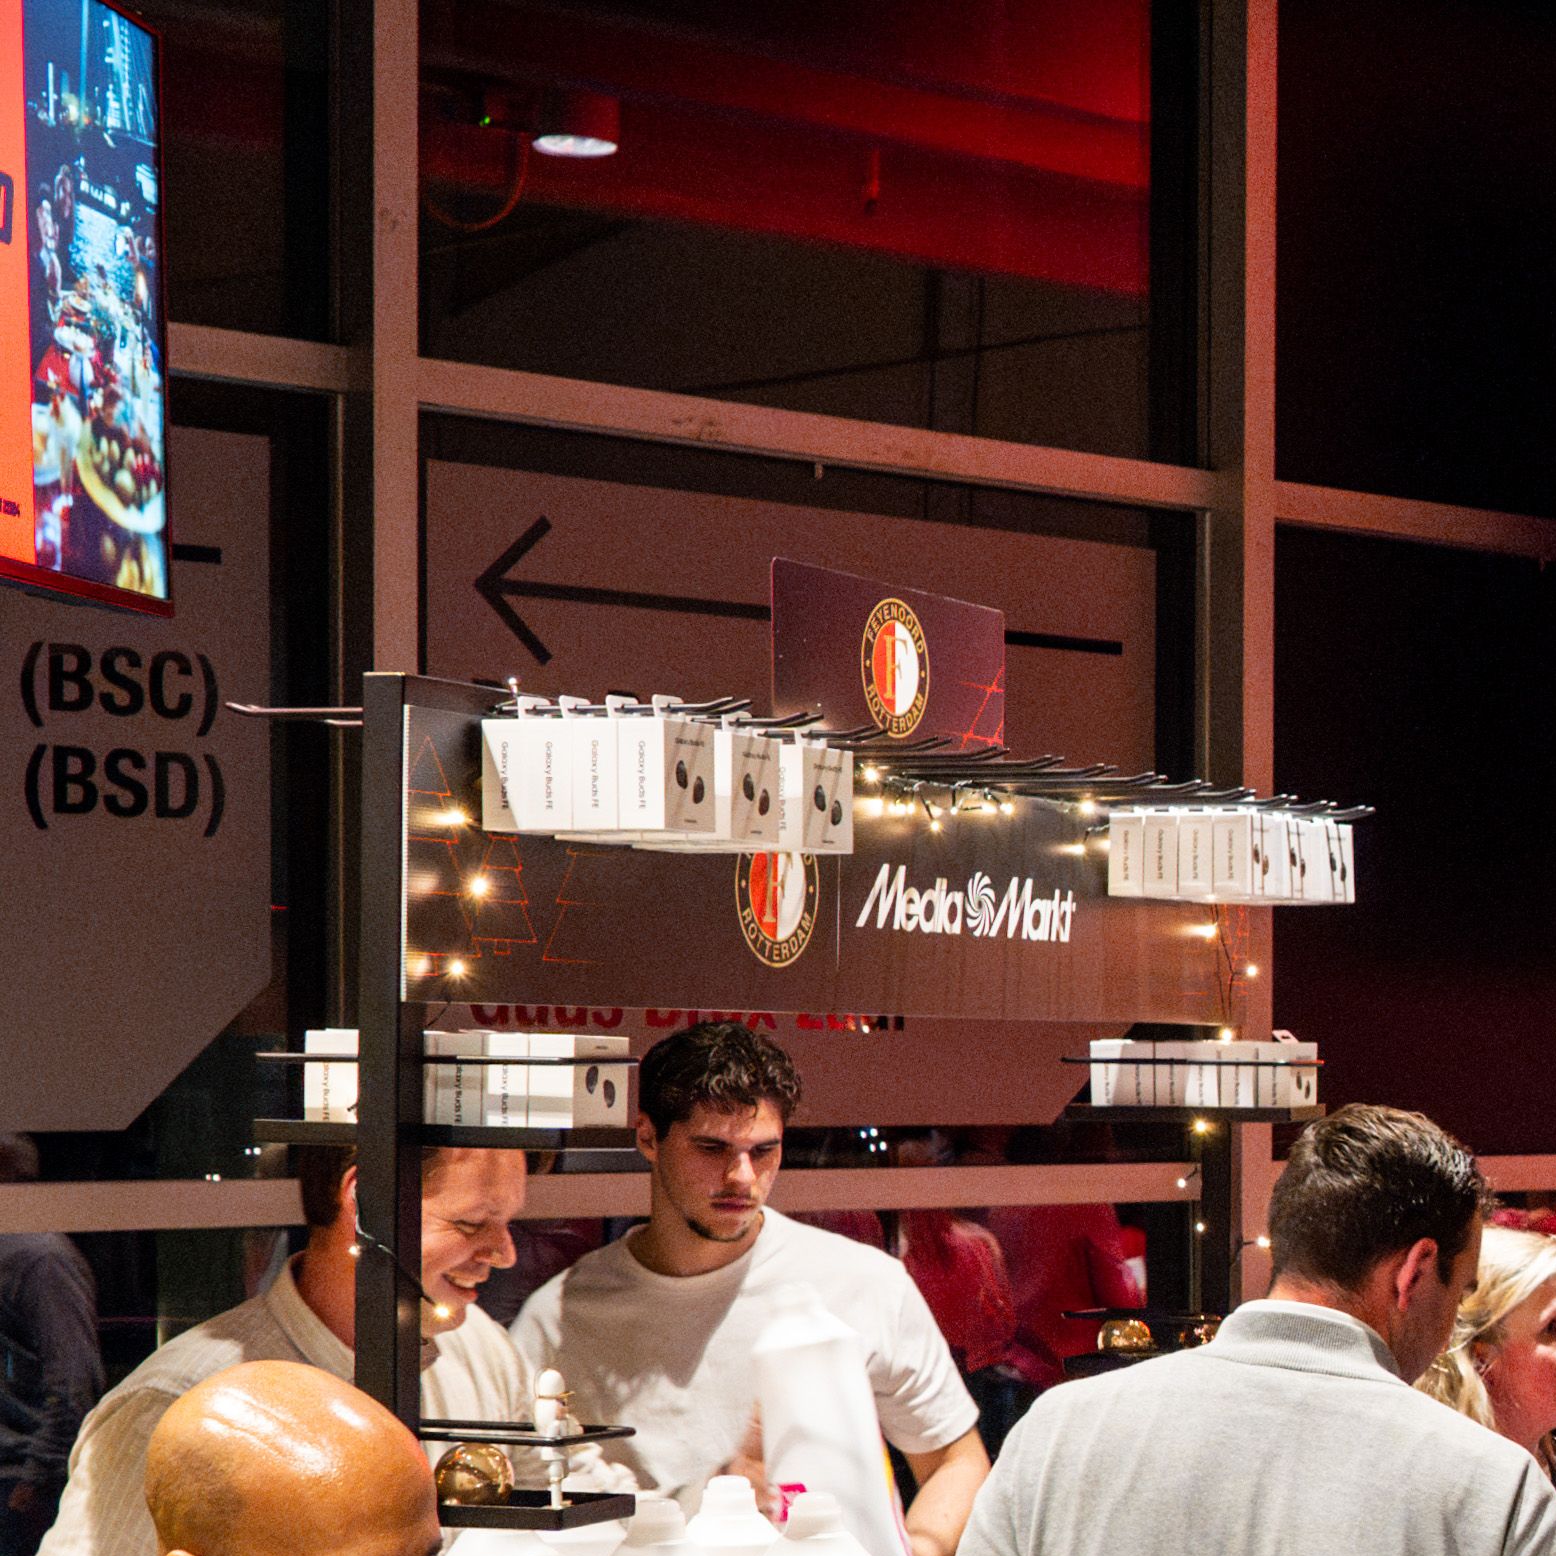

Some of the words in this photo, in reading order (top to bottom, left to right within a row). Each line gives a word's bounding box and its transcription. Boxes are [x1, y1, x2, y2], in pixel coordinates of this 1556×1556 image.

[866, 603, 924, 654] FEYENOORD
[21, 641, 218, 736] (BSC)
[867, 682, 924, 732] ROTTERDAM
[25, 743, 225, 837] (BSD)
[742, 906, 812, 960] ROTTERDAM
